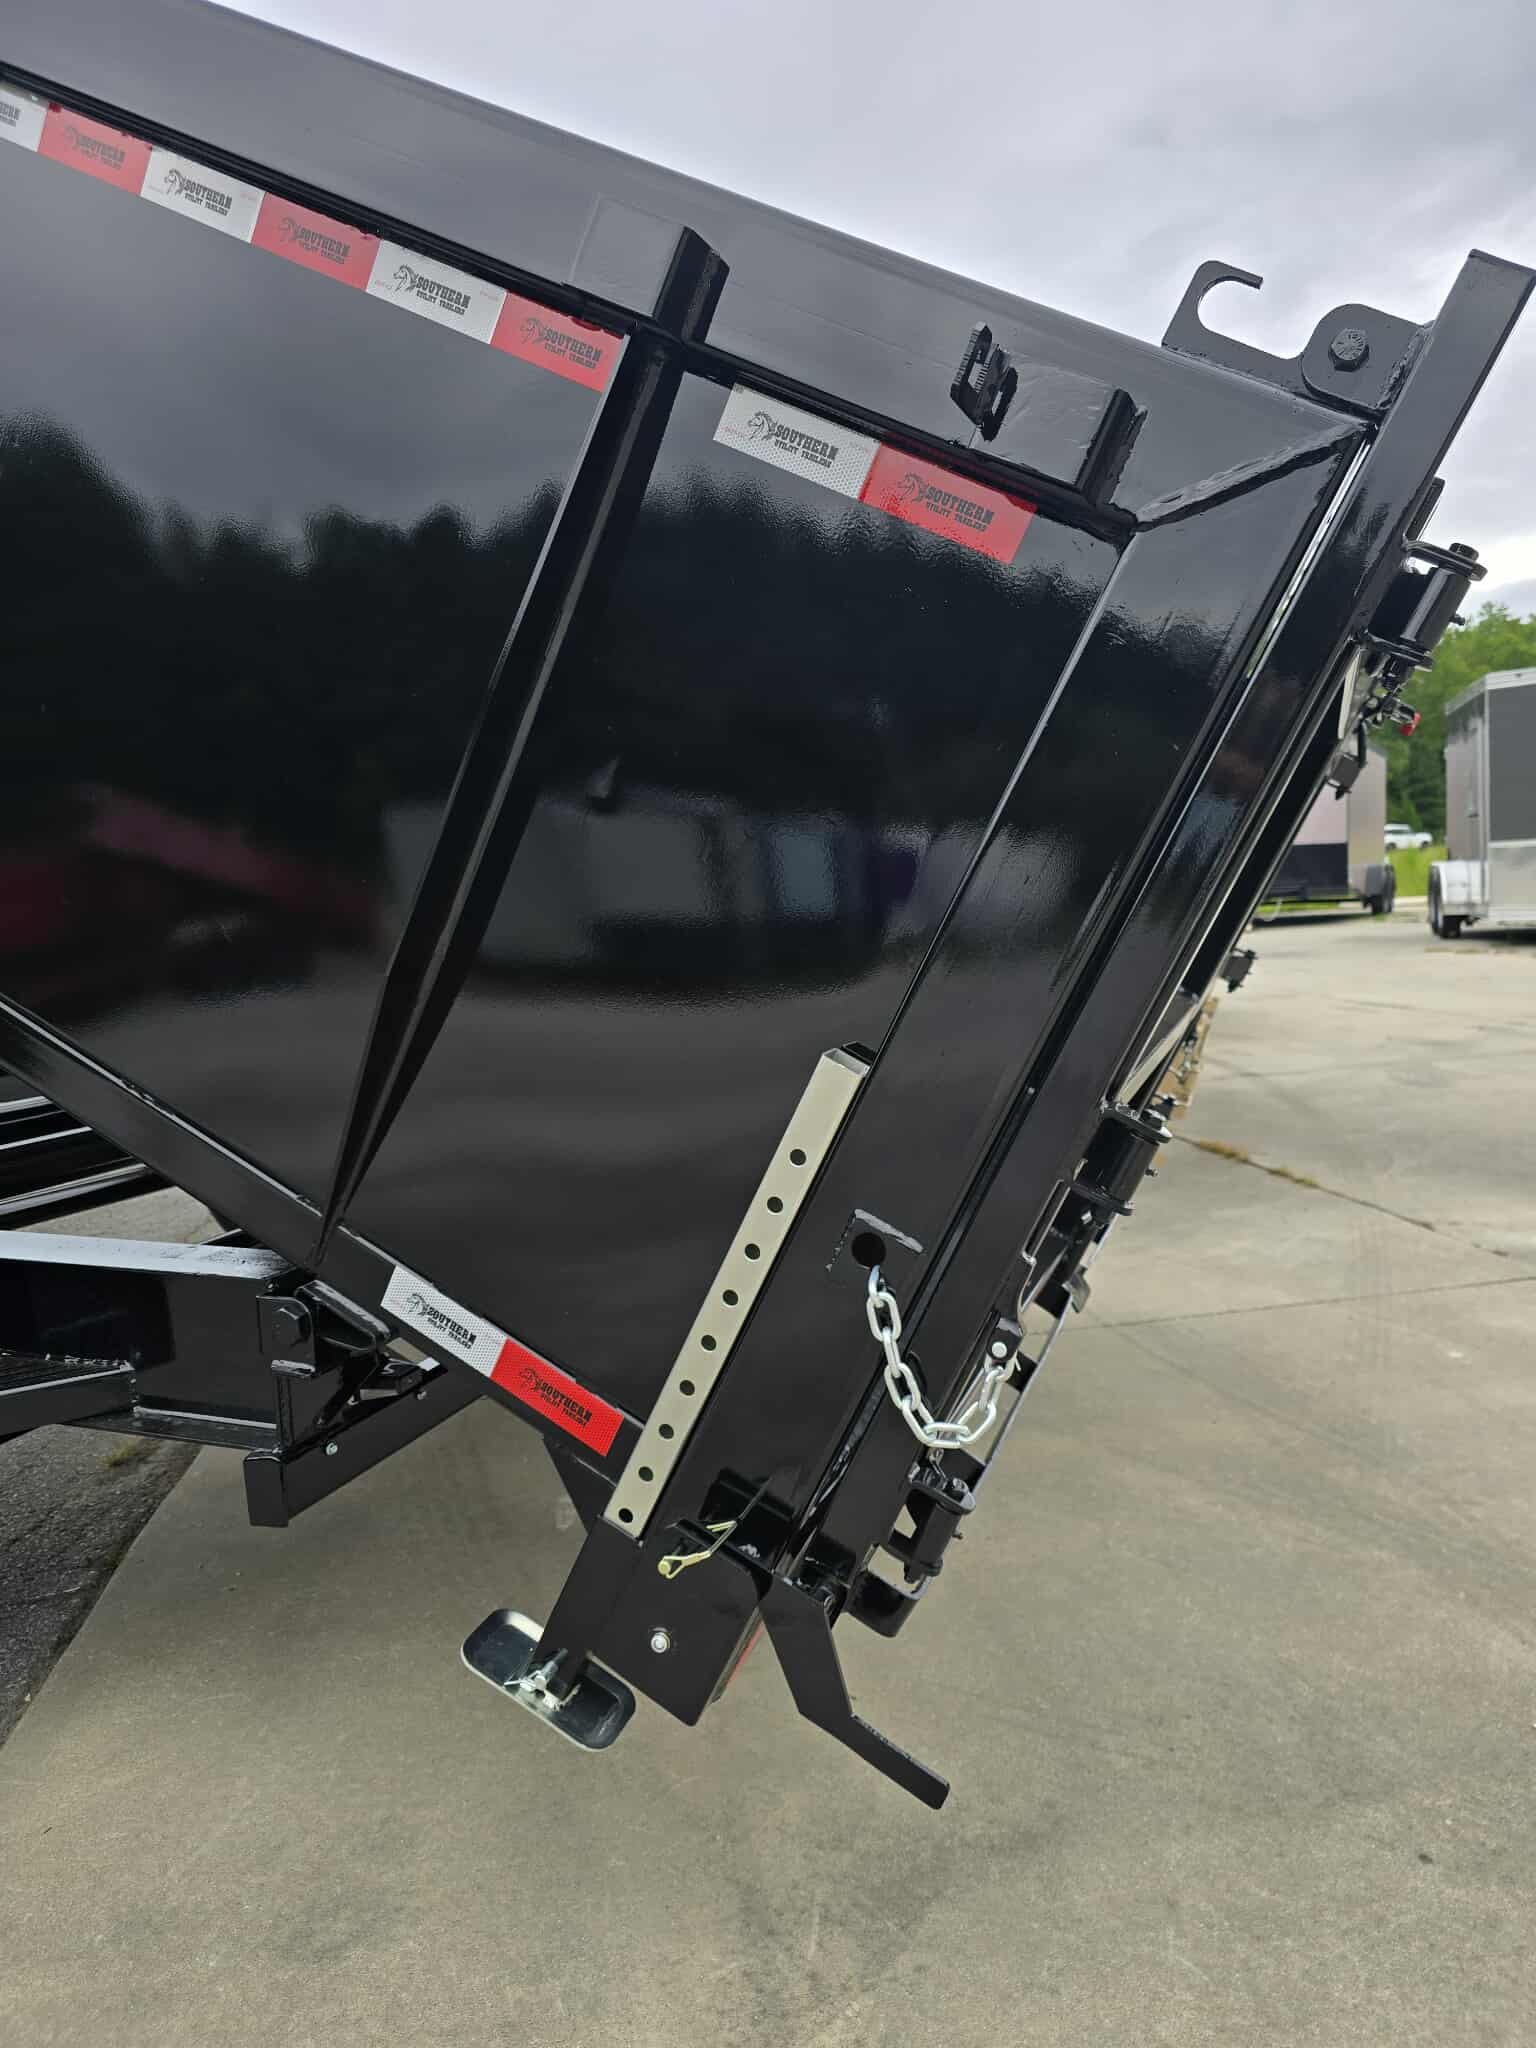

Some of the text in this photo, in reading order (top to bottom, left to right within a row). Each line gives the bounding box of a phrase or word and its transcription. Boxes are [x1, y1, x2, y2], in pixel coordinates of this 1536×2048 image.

[184, 179, 233, 209] SOUTHERN
[300, 227, 351, 257] SOUTHERN
[416, 276, 471, 308] SOUTHERN
[544, 328, 603, 362] SOUTHERN
[774, 439, 832, 468] UTILITY TRAILERS
[775, 424, 840, 460] SOUTHERN
[926, 486, 995, 524] SOUTHERN
[926, 502, 988, 532] UTILITY TRAILERS
[427, 1306, 477, 1345] SOUTHERN
[541, 1382, 592, 1422] SOUTHERN
